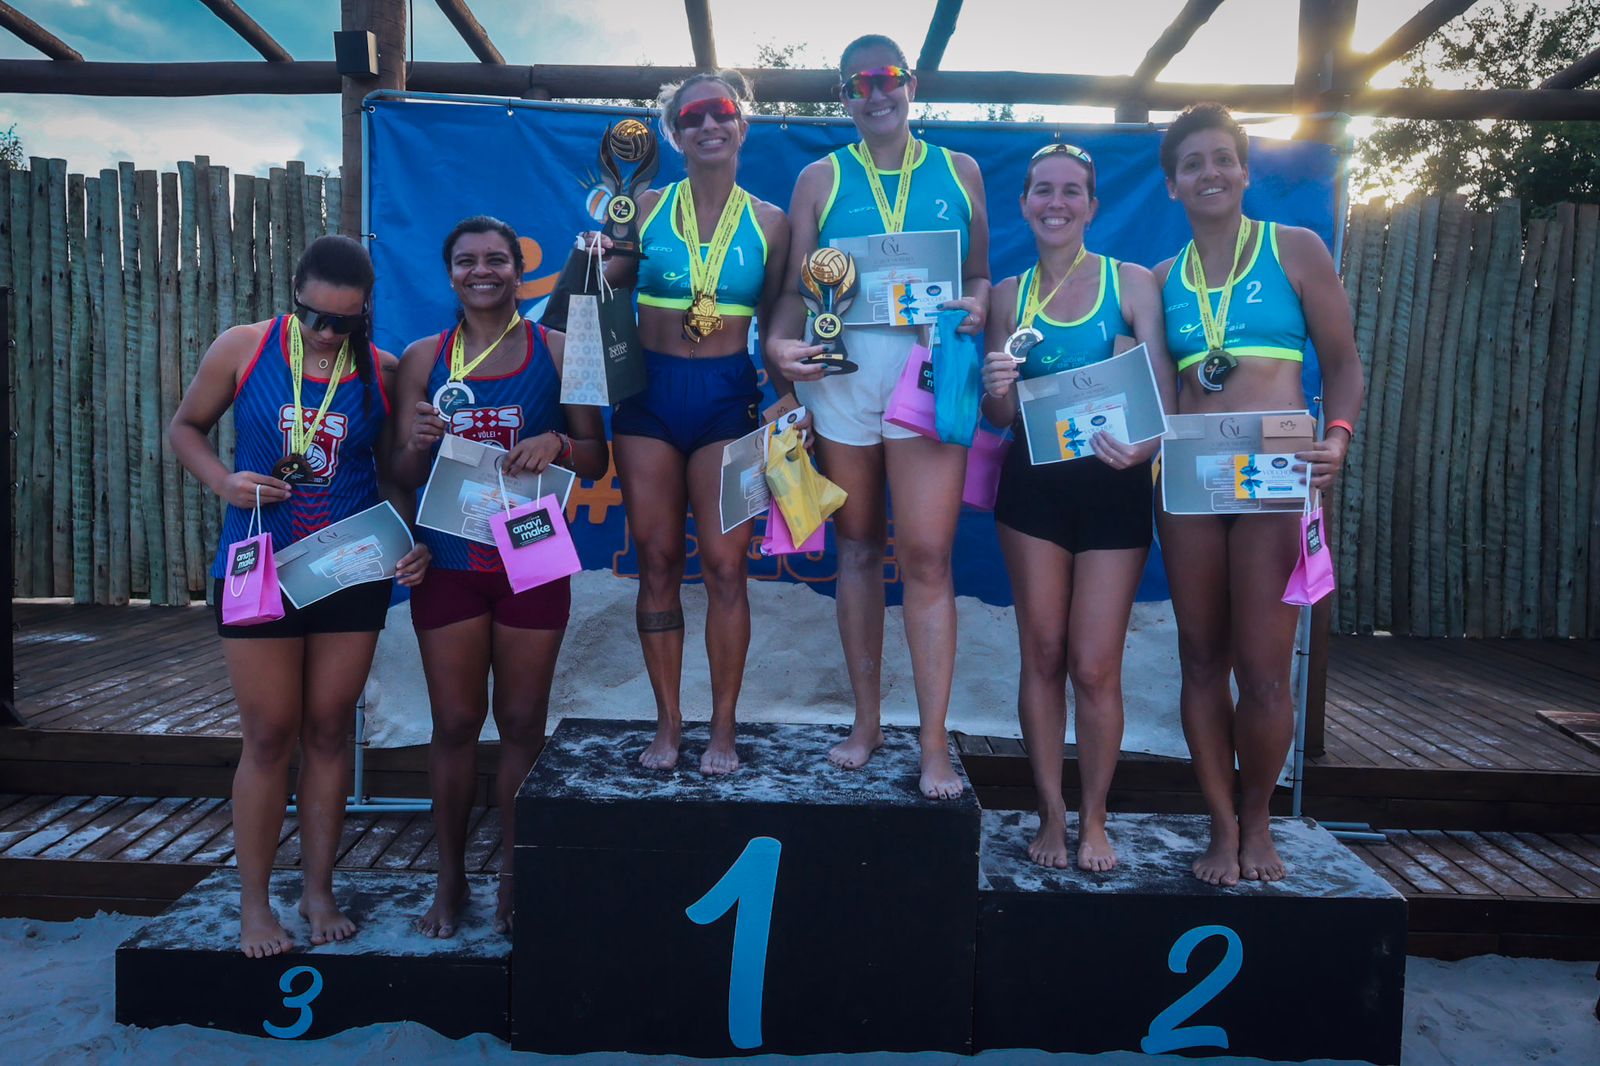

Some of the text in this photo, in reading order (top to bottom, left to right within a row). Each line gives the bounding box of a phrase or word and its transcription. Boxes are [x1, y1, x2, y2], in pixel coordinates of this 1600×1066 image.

[935, 199, 949, 220] 2
[733, 245, 745, 266] 1
[1246, 280, 1263, 304] 2
[1097, 320, 1108, 341] 1
[512, 518, 542, 534] anavi
[521, 524, 551, 541] make
[238, 557, 256, 569] make
[686, 837, 783, 1049] 1
[1140, 925, 1243, 1055] 2
[263, 966, 323, 1038] 3
